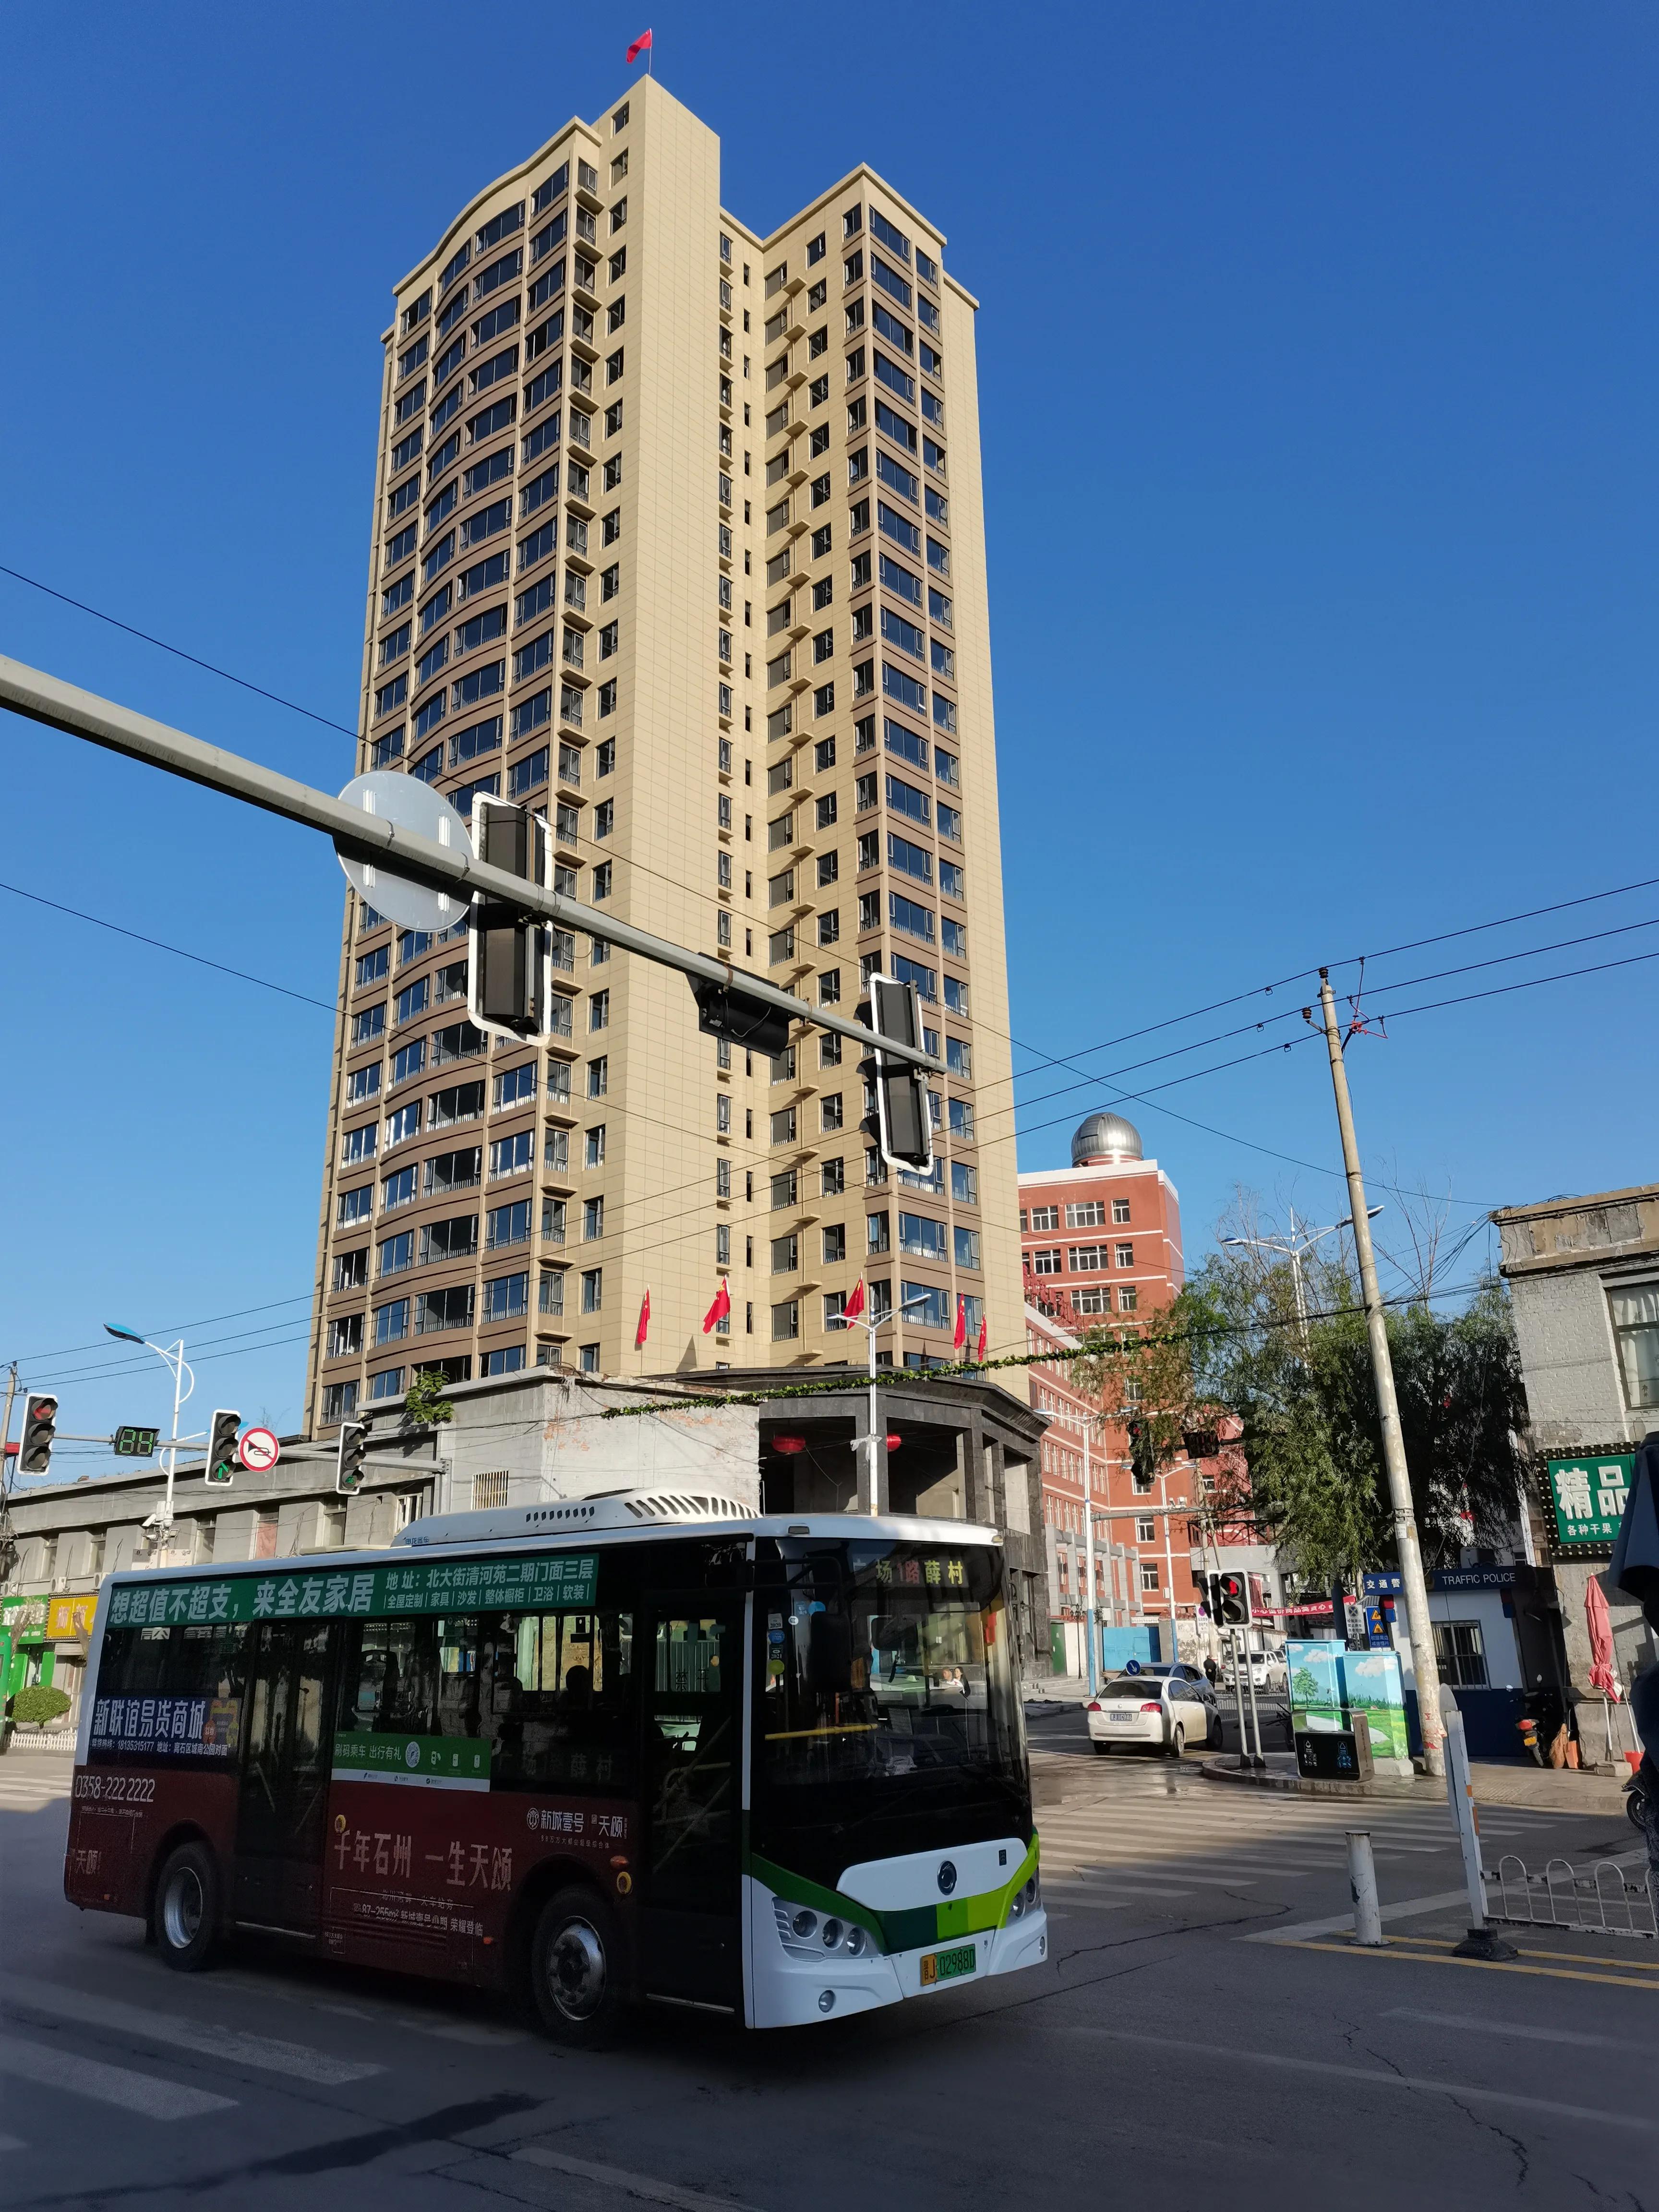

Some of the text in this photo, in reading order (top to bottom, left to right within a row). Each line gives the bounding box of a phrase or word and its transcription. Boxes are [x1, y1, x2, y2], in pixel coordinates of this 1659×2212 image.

[120, 1429, 154, 1454] 24
[1554, 1466, 1630, 1519] 精品
[1567, 1523, 1617, 1536] 各种干果
[427, 1559, 594, 1588] 北大街清河苑二期门面三层
[1442, 1573, 1516, 1585] TRAFFIC POLICE
[252, 1574, 375, 1617] 来全友家居
[541, 1809, 584, 1833] 新城壹号
[599, 1815, 623, 1838] 天颂
[334, 1829, 512, 1892] 千年石州 一生天颂
